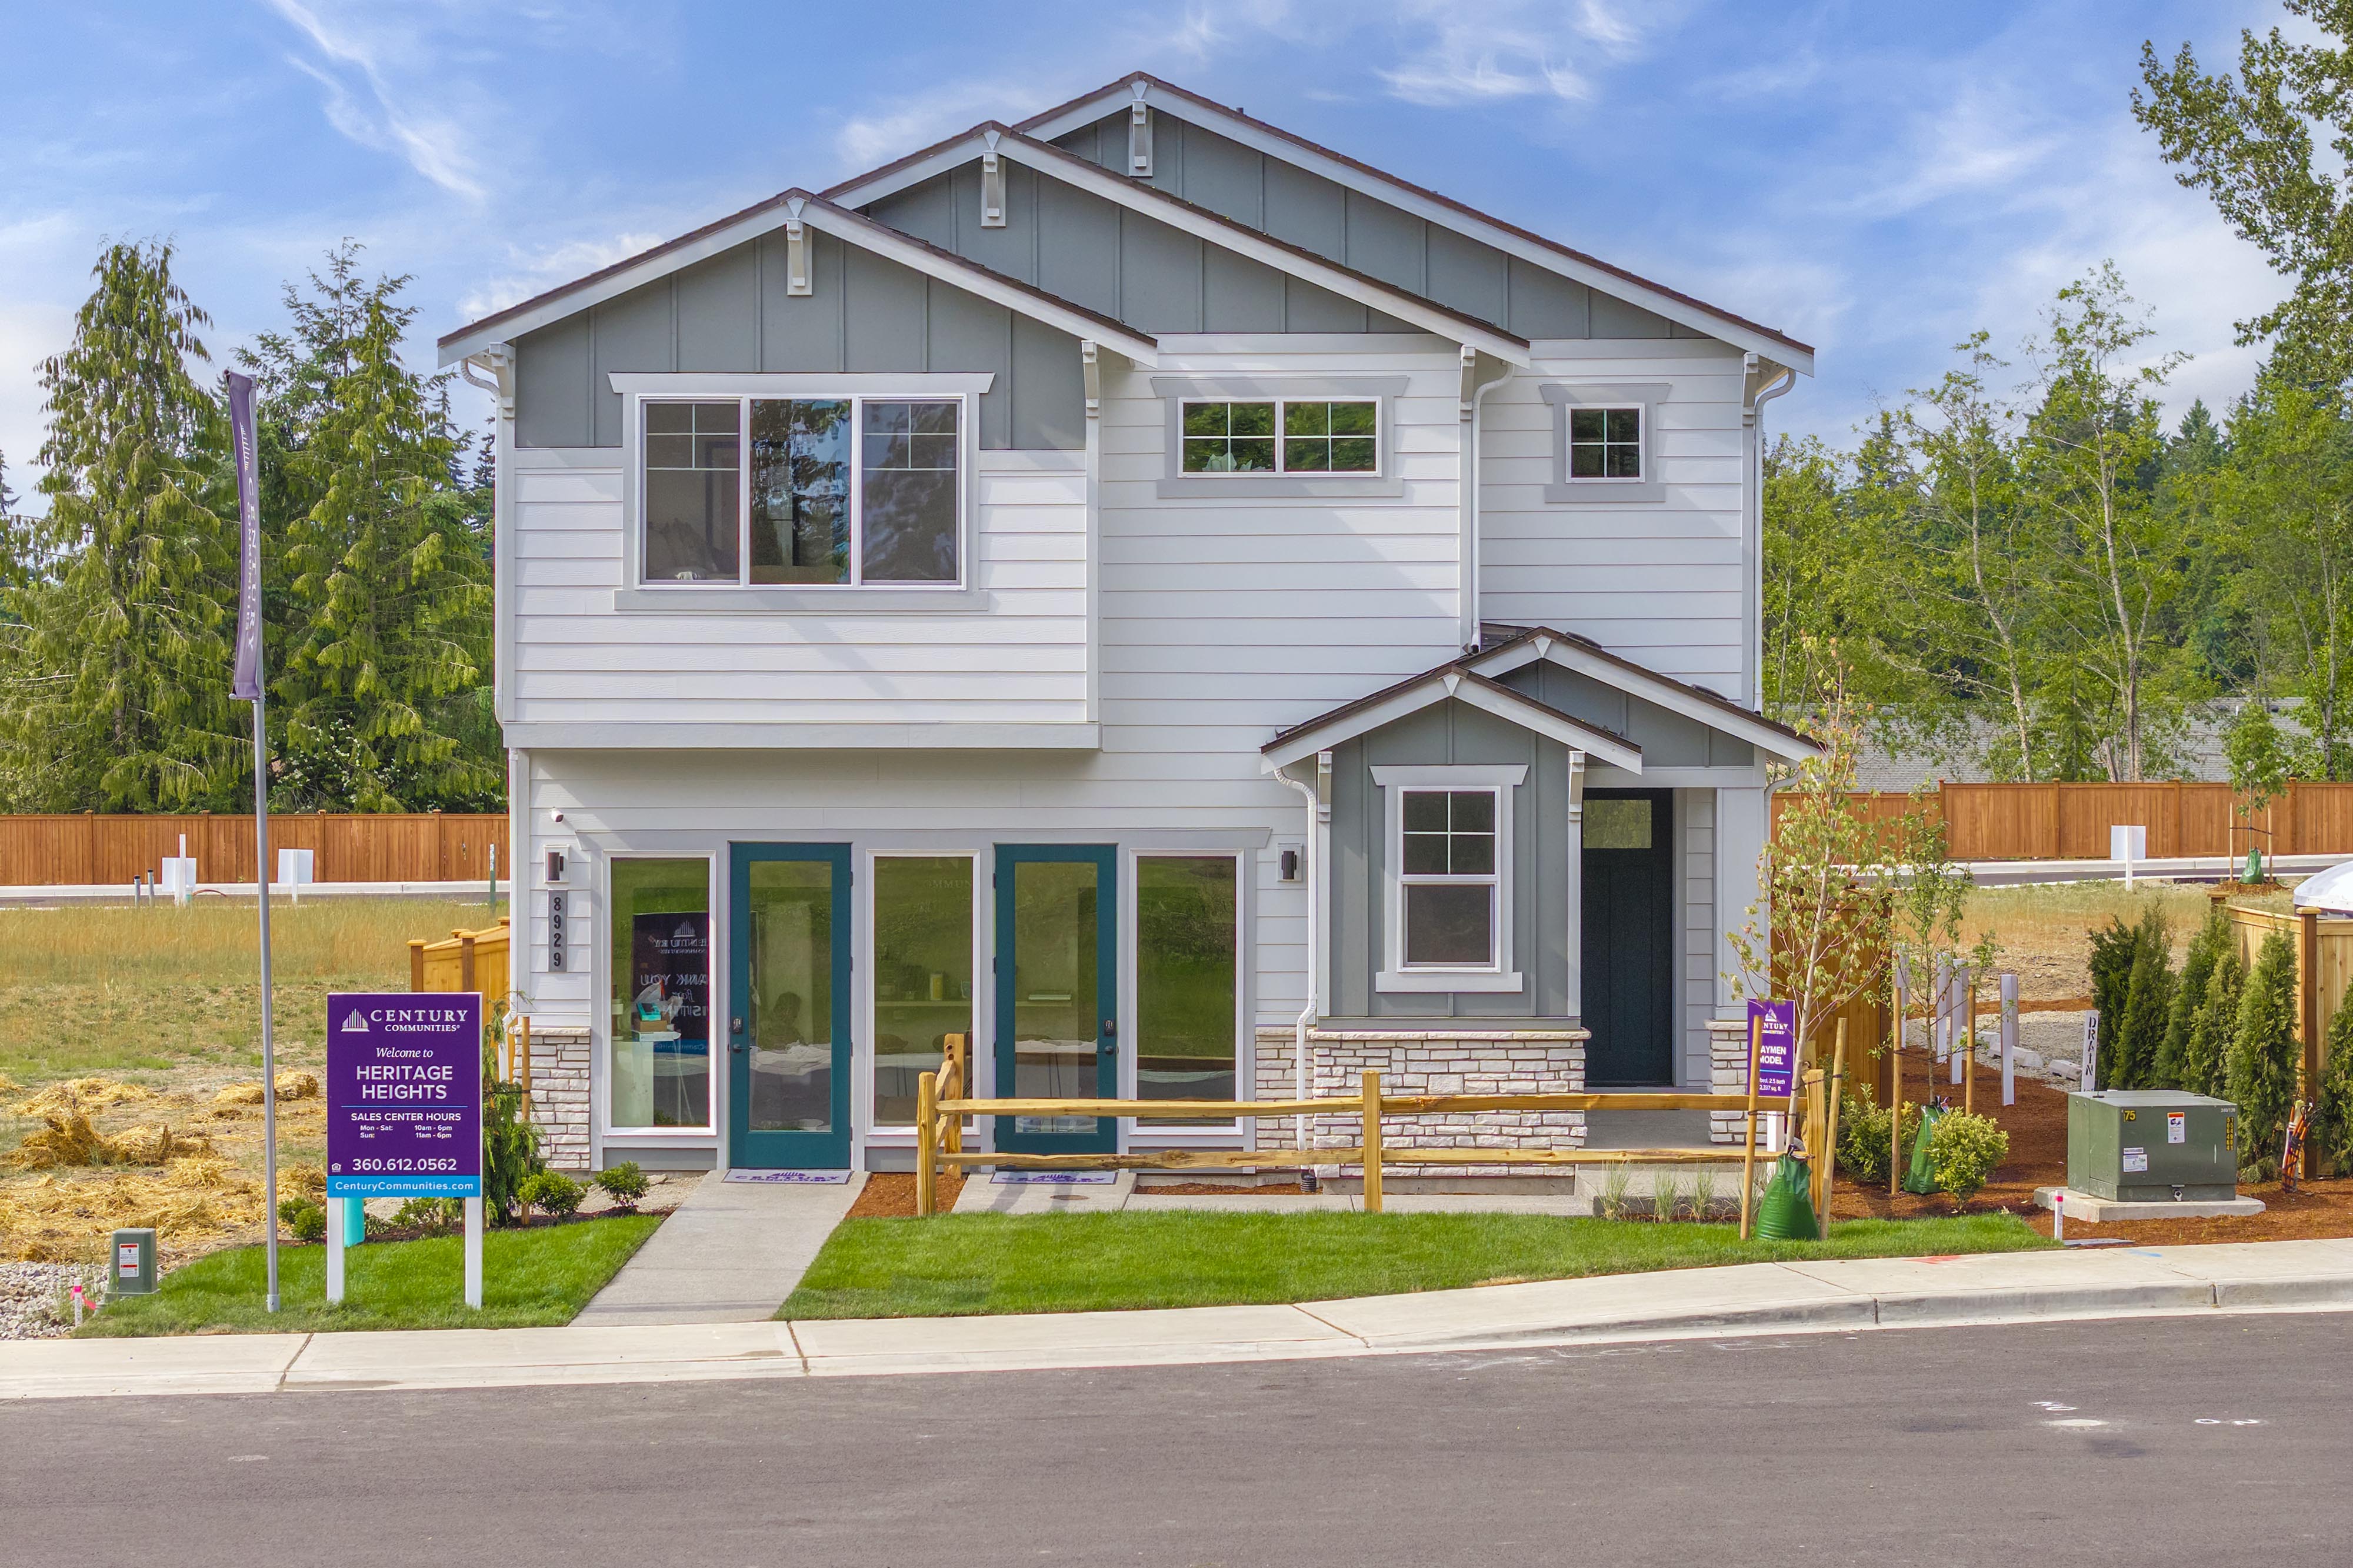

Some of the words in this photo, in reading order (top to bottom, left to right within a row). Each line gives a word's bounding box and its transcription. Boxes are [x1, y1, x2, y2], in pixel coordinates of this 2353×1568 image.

[248, 476, 256, 652] CENTURY
[553, 897, 561, 966] 8929
[370, 1009, 468, 1022] CENTURY
[1761, 1045, 1787, 1055] AYMEN
[2085, 1016, 2097, 1076] DRAIN
[376, 1047, 421, 1058] Welcome
[423, 1049, 434, 1058] to
[1759, 1056, 1784, 1065] MODEL
[356, 1065, 453, 1080] HERITAGE
[362, 1084, 447, 1100] HEIGHTS
[351, 1113, 382, 1121] SALES
[384, 1113, 423, 1121] CENTER
[426, 1113, 461, 1121] HOURS
[2124, 1110, 2136, 1120] 75
[352, 1158, 457, 1170] 360.612.0562
[335, 1181, 474, 1192] CenturyCommunities.com
